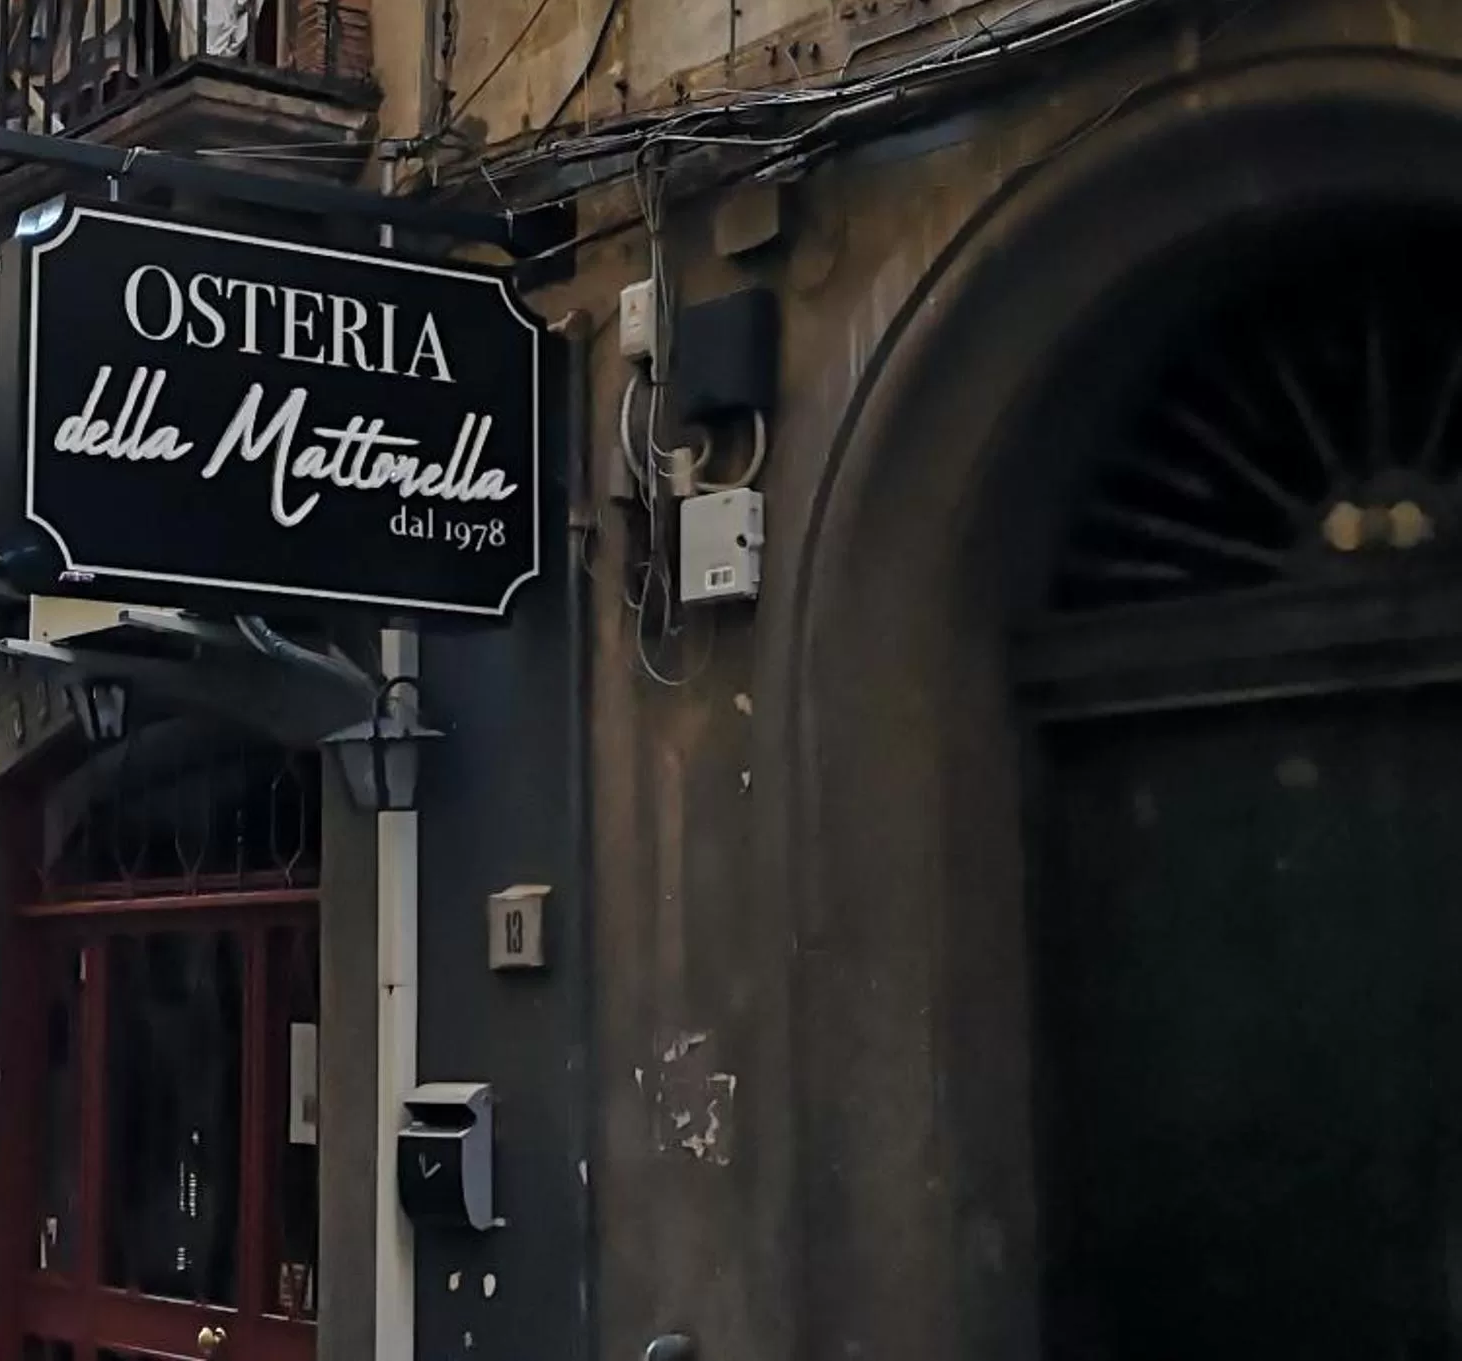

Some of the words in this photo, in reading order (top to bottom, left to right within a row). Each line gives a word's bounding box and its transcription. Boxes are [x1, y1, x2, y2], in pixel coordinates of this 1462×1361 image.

[124, 263, 455, 383] OSTERIA
[53, 365, 194, 461] della
[201, 382, 519, 527] Mattonella
[389, 504, 434, 539] dal
[442, 518, 506, 552] 1978
